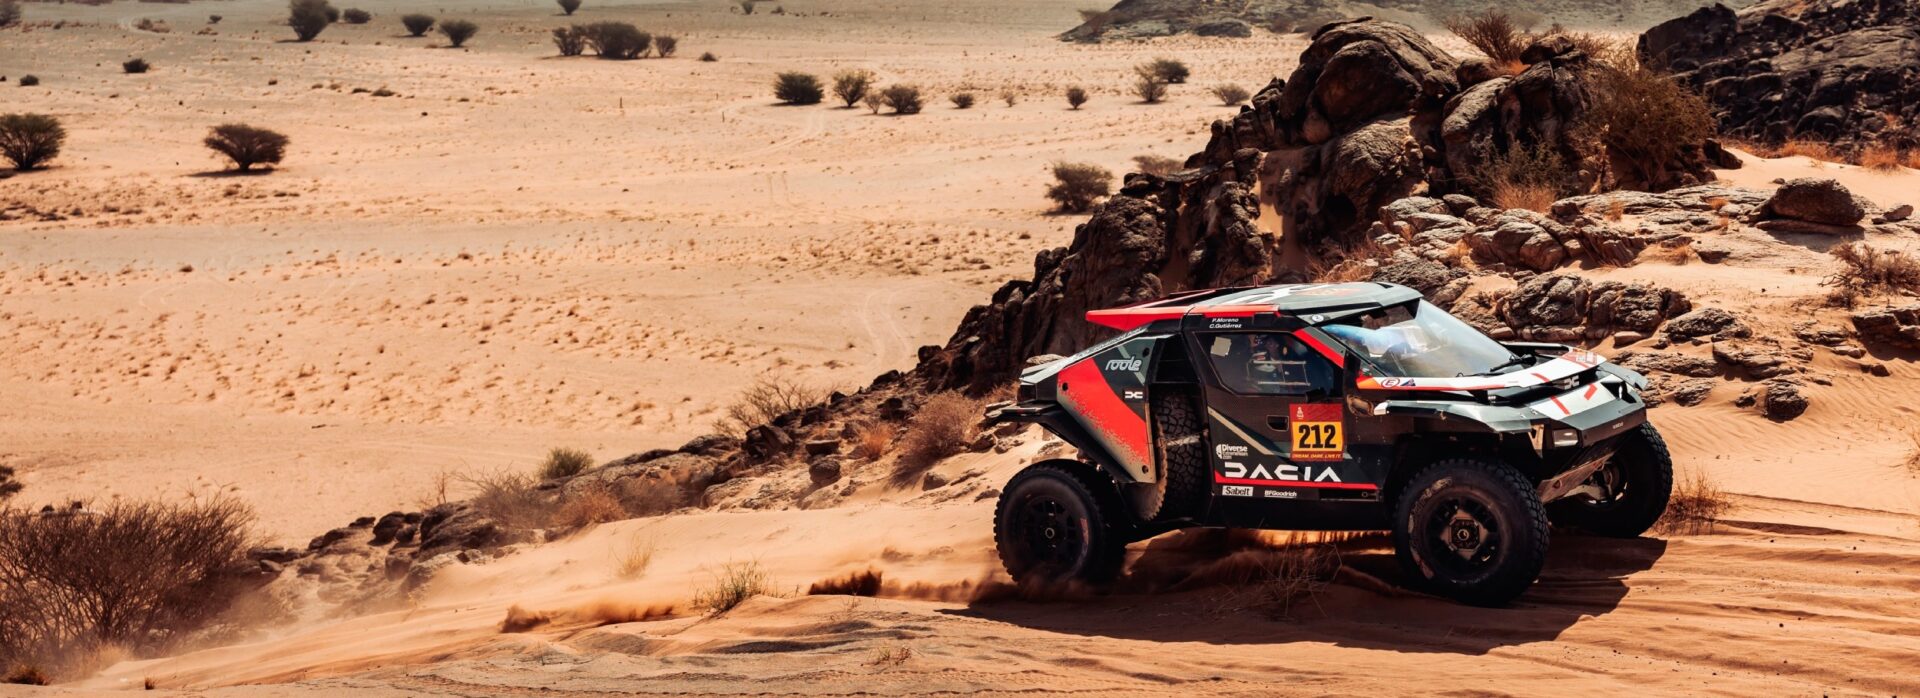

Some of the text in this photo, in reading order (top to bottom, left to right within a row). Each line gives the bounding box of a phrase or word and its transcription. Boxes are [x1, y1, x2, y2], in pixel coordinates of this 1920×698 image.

[1298, 424, 1337, 449] 212
[1222, 444, 1248, 452] Diverse
[1224, 462, 1342, 482] DACIA
[1225, 486, 1250, 496] Sabelt
[1264, 489, 1298, 497] BFGoodrich
